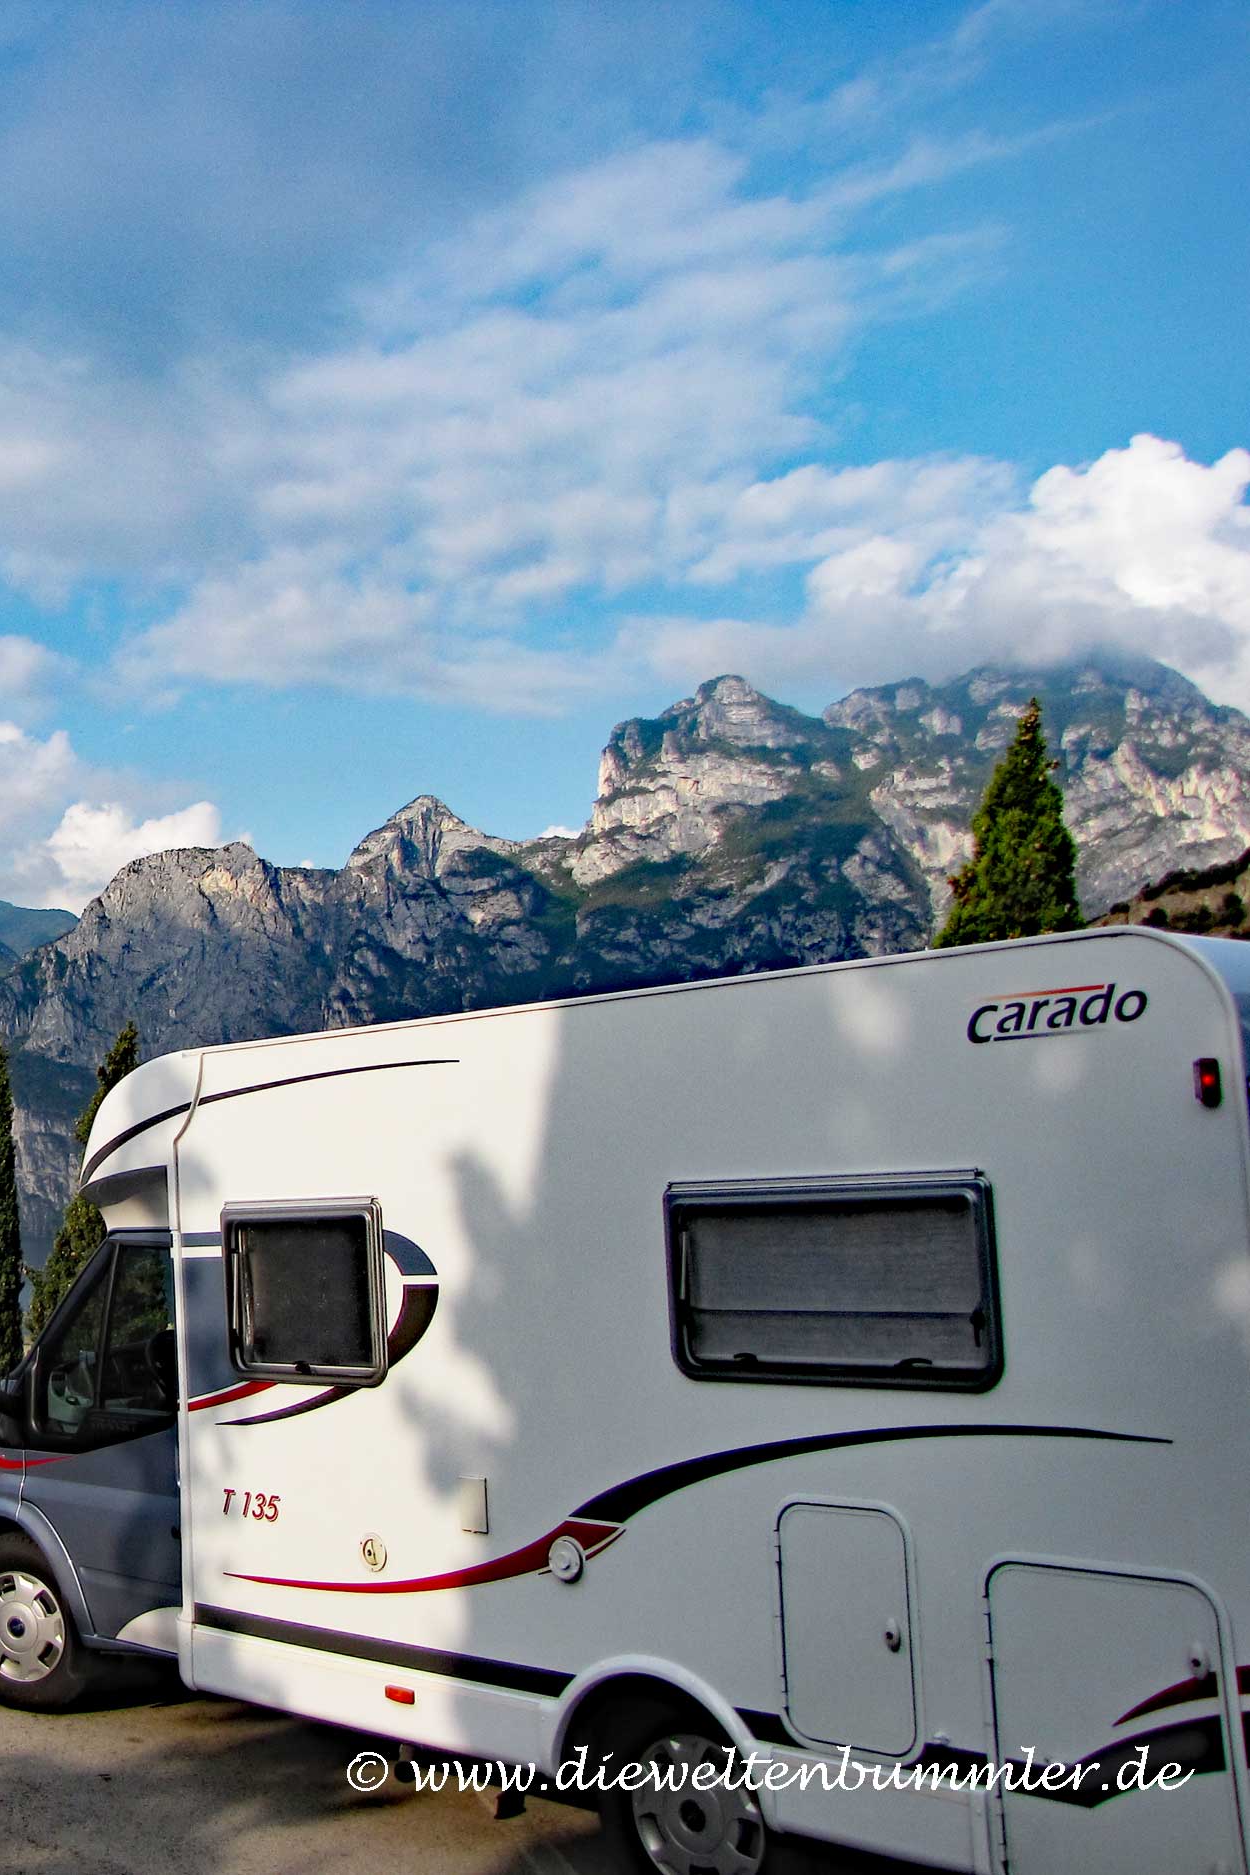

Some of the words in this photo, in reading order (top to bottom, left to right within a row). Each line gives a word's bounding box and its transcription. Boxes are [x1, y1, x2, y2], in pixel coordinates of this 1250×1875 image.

[967, 983, 1148, 1043] carado
[223, 1489, 236, 1515] T
[242, 1491, 281, 1522] 135
